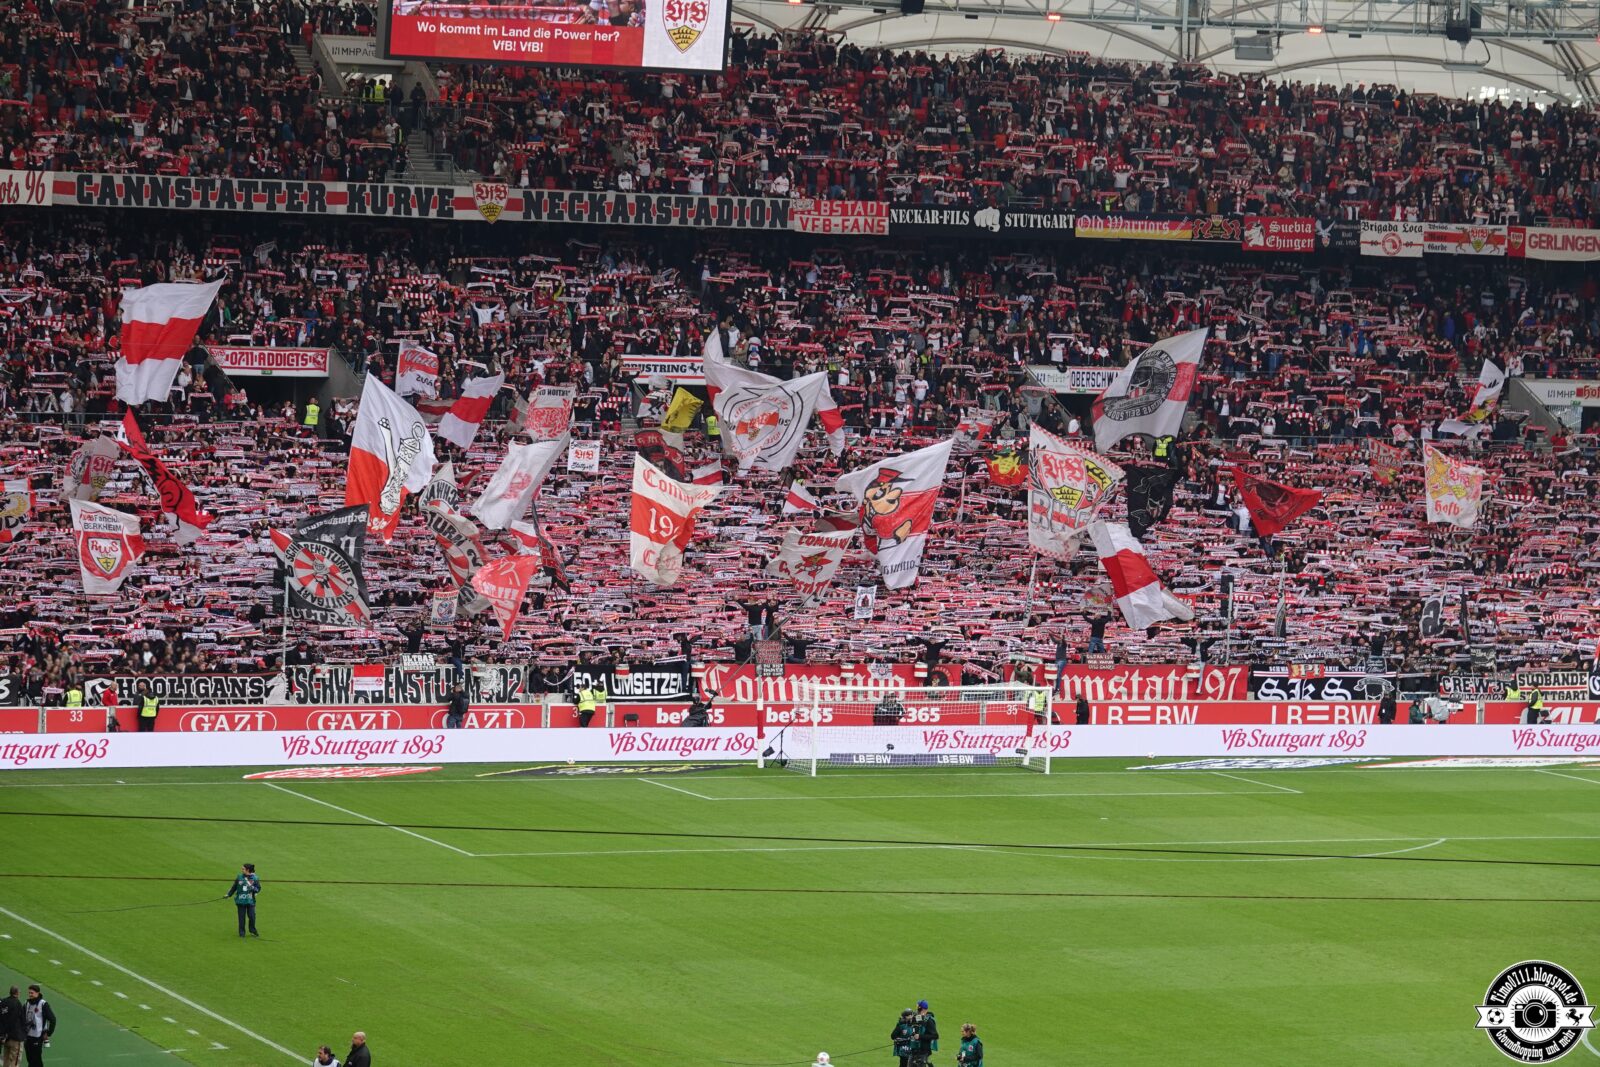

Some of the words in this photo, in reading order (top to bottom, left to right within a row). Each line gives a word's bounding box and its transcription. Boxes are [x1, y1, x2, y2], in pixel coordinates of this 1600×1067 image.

[417, 21, 436, 33] Wo
[439, 24, 481, 35] kommt
[484, 25, 498, 36] im
[501, 27, 531, 38] Land
[534, 29, 551, 39] die
[554, 29, 592, 41] Power
[594, 31, 620, 42] her?
[492, 40, 516, 51] VfB!
[520, 41, 543, 52] VfB!
[25, 171, 46, 205] 96
[76, 174, 327, 213] CANNSTATTER
[347, 182, 455, 218] KURVE
[522, 190, 791, 229] NECKARSTADION
[889, 208, 970, 225] NECKAR-FILS
[1004, 212, 1076, 229] STUTTGART
[799, 216, 886, 234] VFB-FANS
[1077, 214, 1104, 233] Old
[1107, 215, 1170, 235] Warriors
[1268, 220, 1313, 234] Suebia
[1361, 221, 1398, 234] Brigada
[1265, 234, 1315, 250] Ehingen
[229, 351, 255, 366] 0711
[258, 351, 309, 367] ADDICTS
[1071, 371, 1119, 388] OBERSCHW
[402, 654, 435, 662] ULTRAS
[1204, 667, 1242, 702] 97
[1441, 676, 1490, 694] CREW
[69, 710, 84, 722] 33
[766, 706, 834, 723] bet365
[1006, 704, 1018, 716] 35
[281, 735, 310, 760] VfB
[310, 734, 399, 761] Stuttgart
[401, 734, 446, 759] 1893
[608, 732, 637, 756] VfB
[636, 731, 721, 757] Stuttgart
[922, 729, 949, 753] VfB
[949, 729, 1028, 755] Stuttgart
[1033, 730, 1072, 753] 1893
[1221, 728, 1247, 751] VfB
[1247, 728, 1326, 753] Stuttgart
[1327, 729, 1368, 751] 1893
[1512, 728, 1537, 751] VfB
[63, 738, 110, 764] 1893
